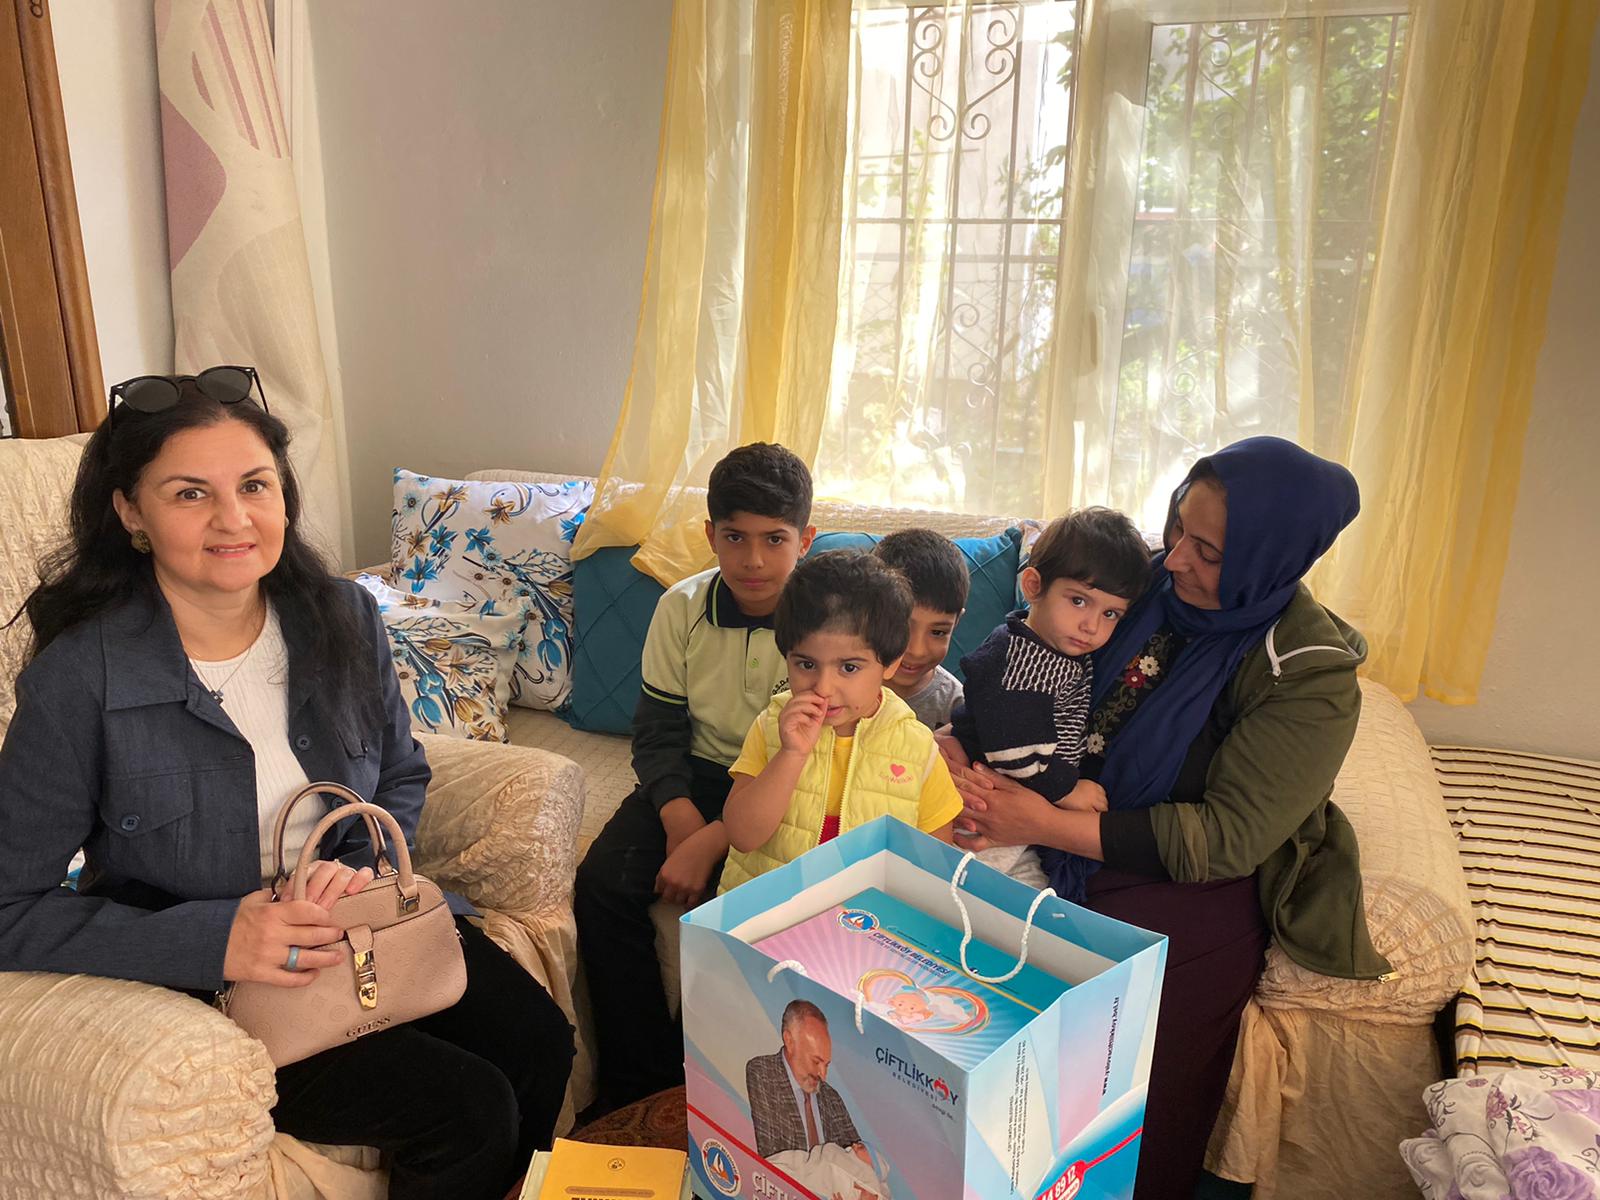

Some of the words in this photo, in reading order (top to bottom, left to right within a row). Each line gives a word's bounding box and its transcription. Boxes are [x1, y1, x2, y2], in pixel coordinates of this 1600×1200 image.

[910, 949, 953, 975] BELEDİYESİ
[346, 1015, 392, 1038] GUESS
[875, 1047, 959, 1106] ÇİFTLİKKÖY
[892, 1071, 938, 1102] BELEDİYESİ
[1055, 1175, 1066, 1198] 89
[1067, 1165, 1077, 1184] 12
